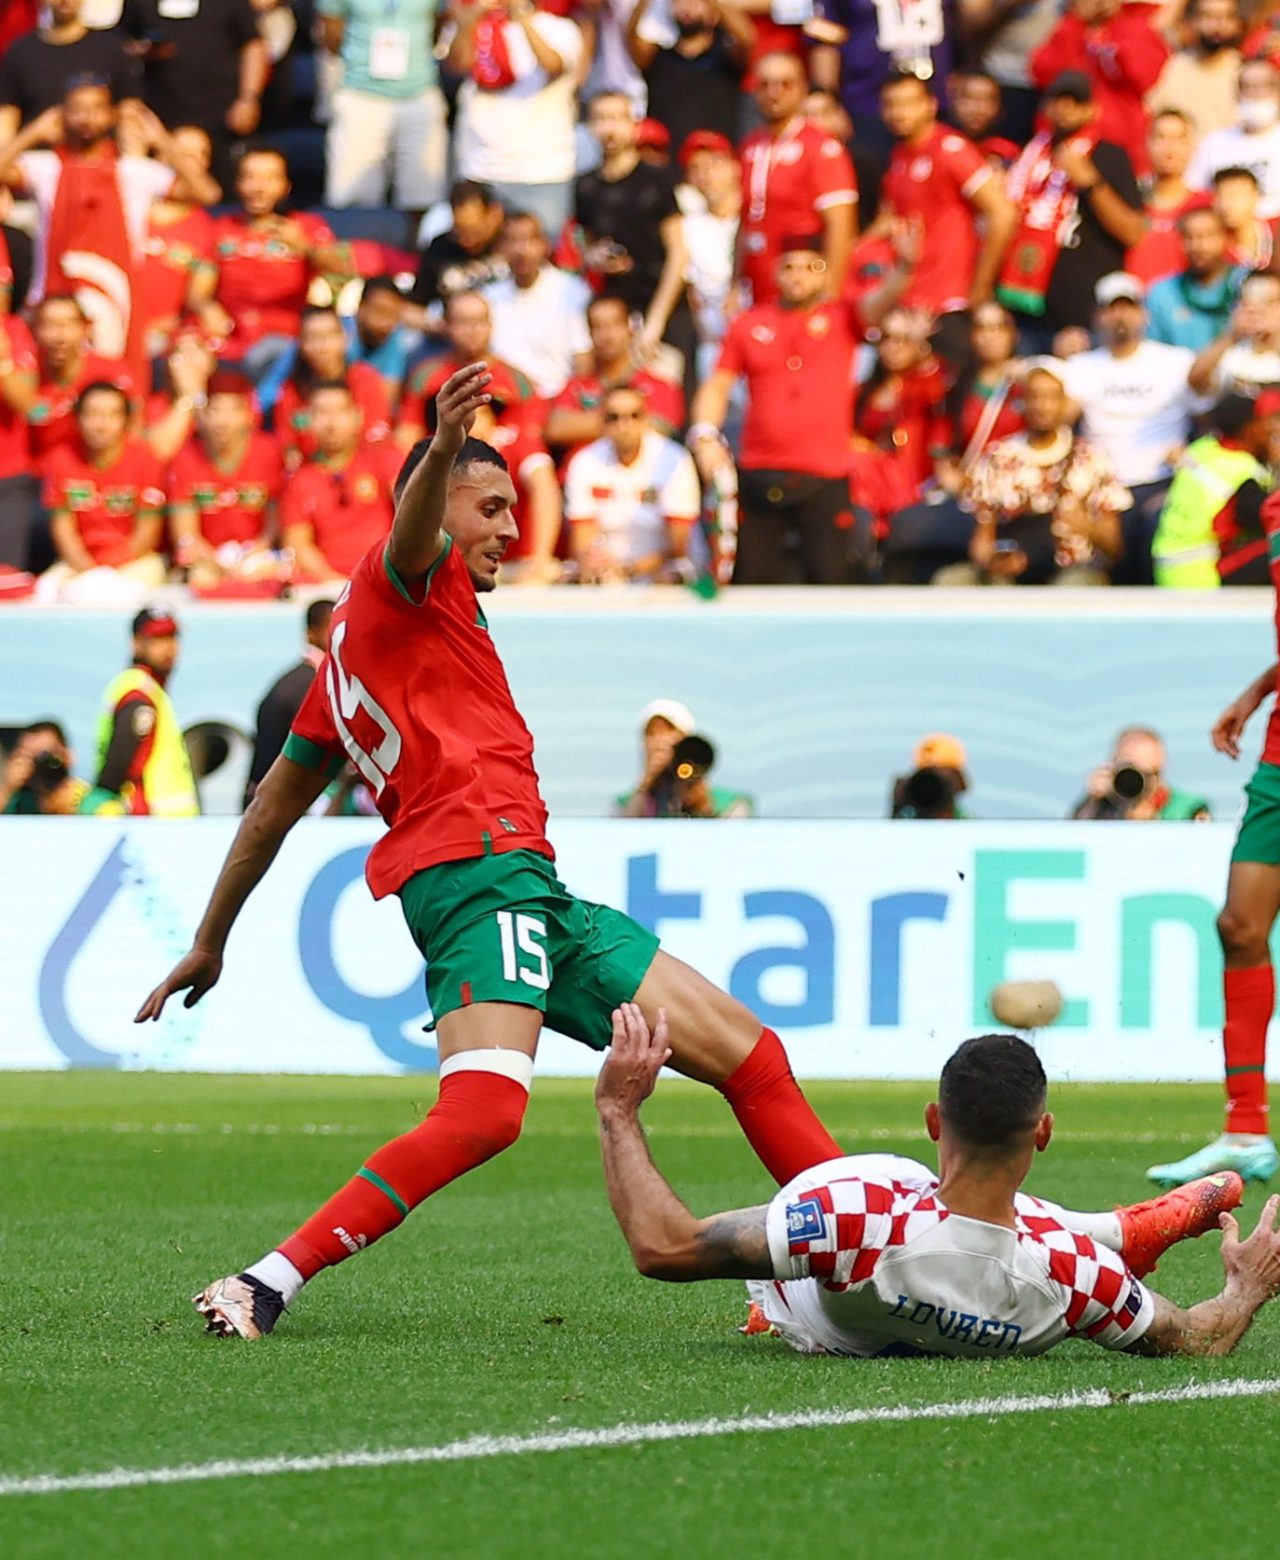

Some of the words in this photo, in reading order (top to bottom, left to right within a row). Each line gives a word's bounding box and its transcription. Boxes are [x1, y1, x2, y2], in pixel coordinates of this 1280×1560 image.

[497, 910, 550, 990] 15
[332, 1226, 359, 1252] PUM
[888, 1294, 1022, 1351] LOVREN
